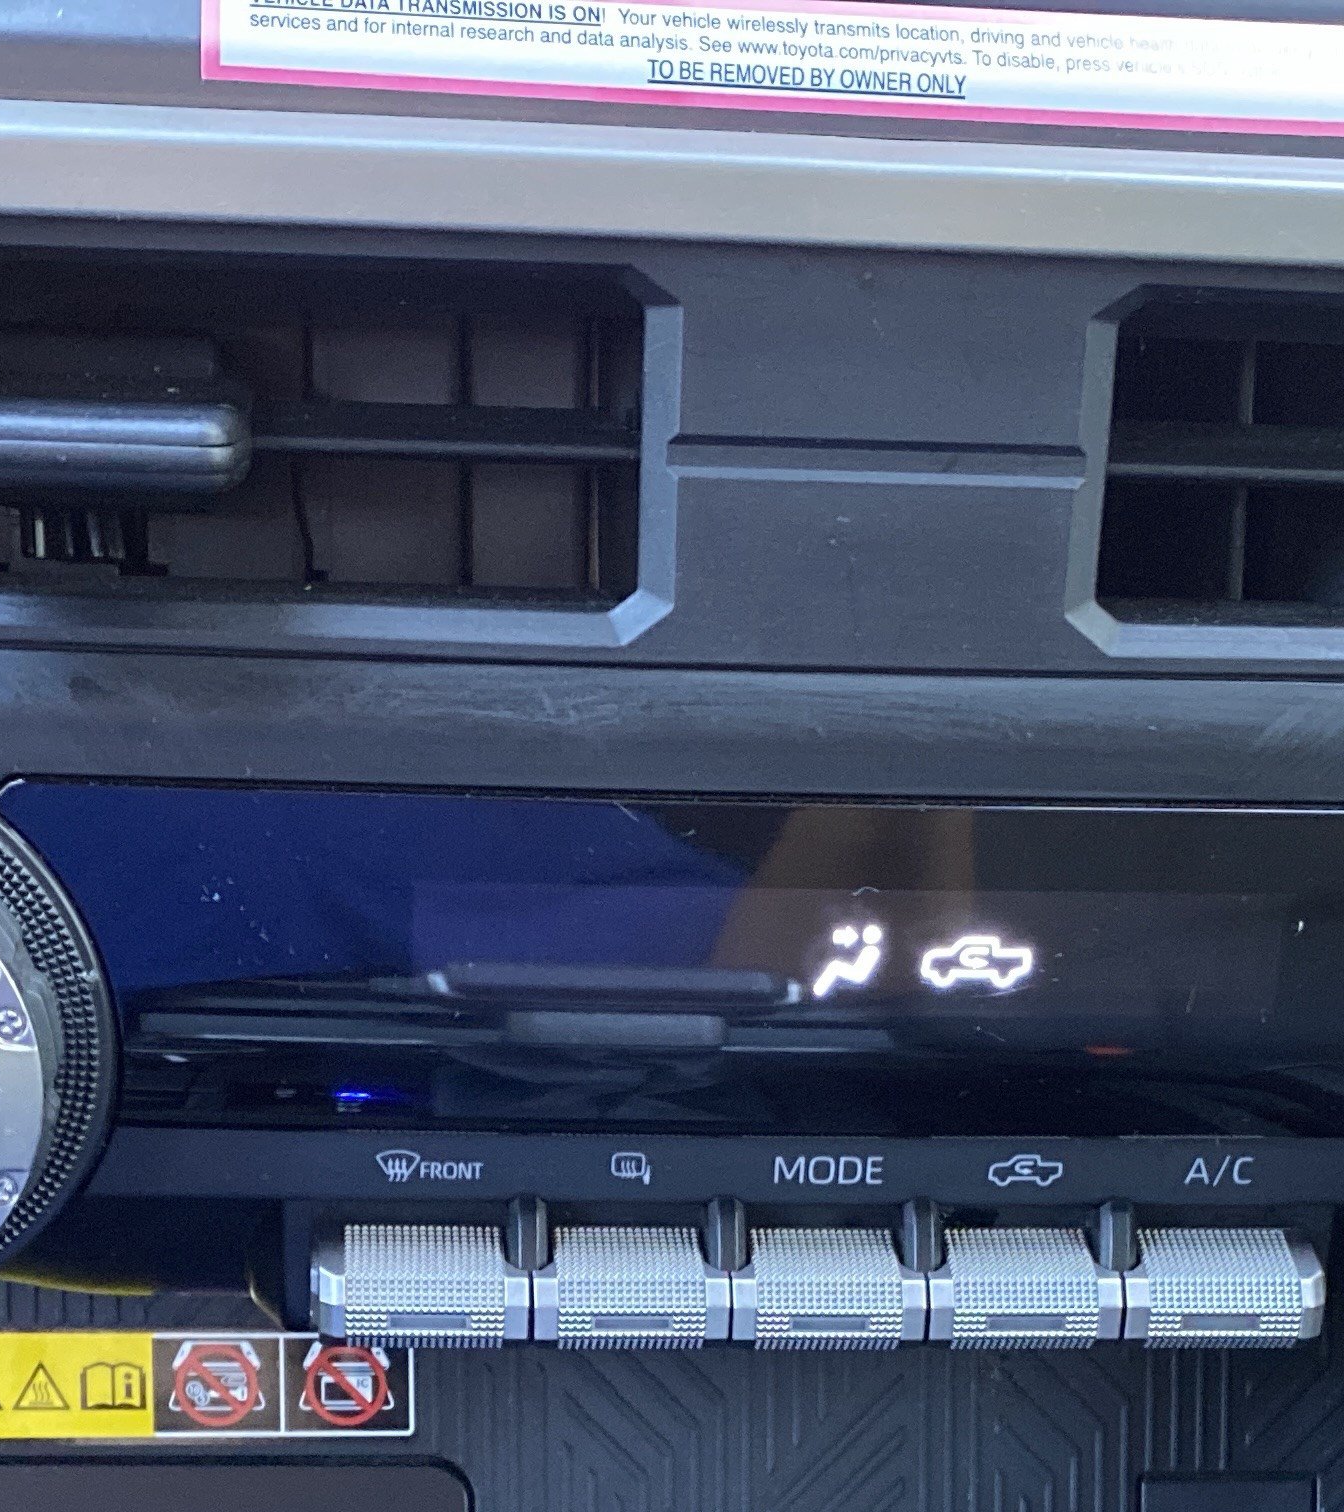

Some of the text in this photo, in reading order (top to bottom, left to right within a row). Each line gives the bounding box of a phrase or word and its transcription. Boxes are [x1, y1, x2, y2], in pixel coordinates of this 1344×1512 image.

[399, 0, 542, 18] TRANSMISSION
[549, 4, 566, 21] IS
[618, 8, 656, 27] Your
[662, 10, 721, 30] vehicle
[727, 14, 809, 38] wirelessly
[814, 20, 890, 39] transmits
[896, 24, 965, 45] location,
[971, 28, 1025, 49] driving
[1031, 31, 1061, 48] and
[1067, 33, 1123, 50] vehicle
[250, 13, 321, 31] services
[326, 17, 358, 33] and
[364, 17, 387, 34] for
[391, 19, 455, 38] internal
[460, 26, 534, 43] research
[540, 29, 572, 45] and
[577, 30, 614, 47] data
[620, 33, 694, 53] analysis.
[699, 36, 732, 53] See
[972, 50, 992, 67] To
[997, 51, 1060, 72] disable,
[1066, 56, 1111, 74] press
[647, 59, 967, 95] TO BE REMOVED BY OWNER ONLY
[420, 1160, 485, 1181] FRONT
[773, 1154, 885, 1186] MODE
[1183, 1154, 1255, 1187] A/C
